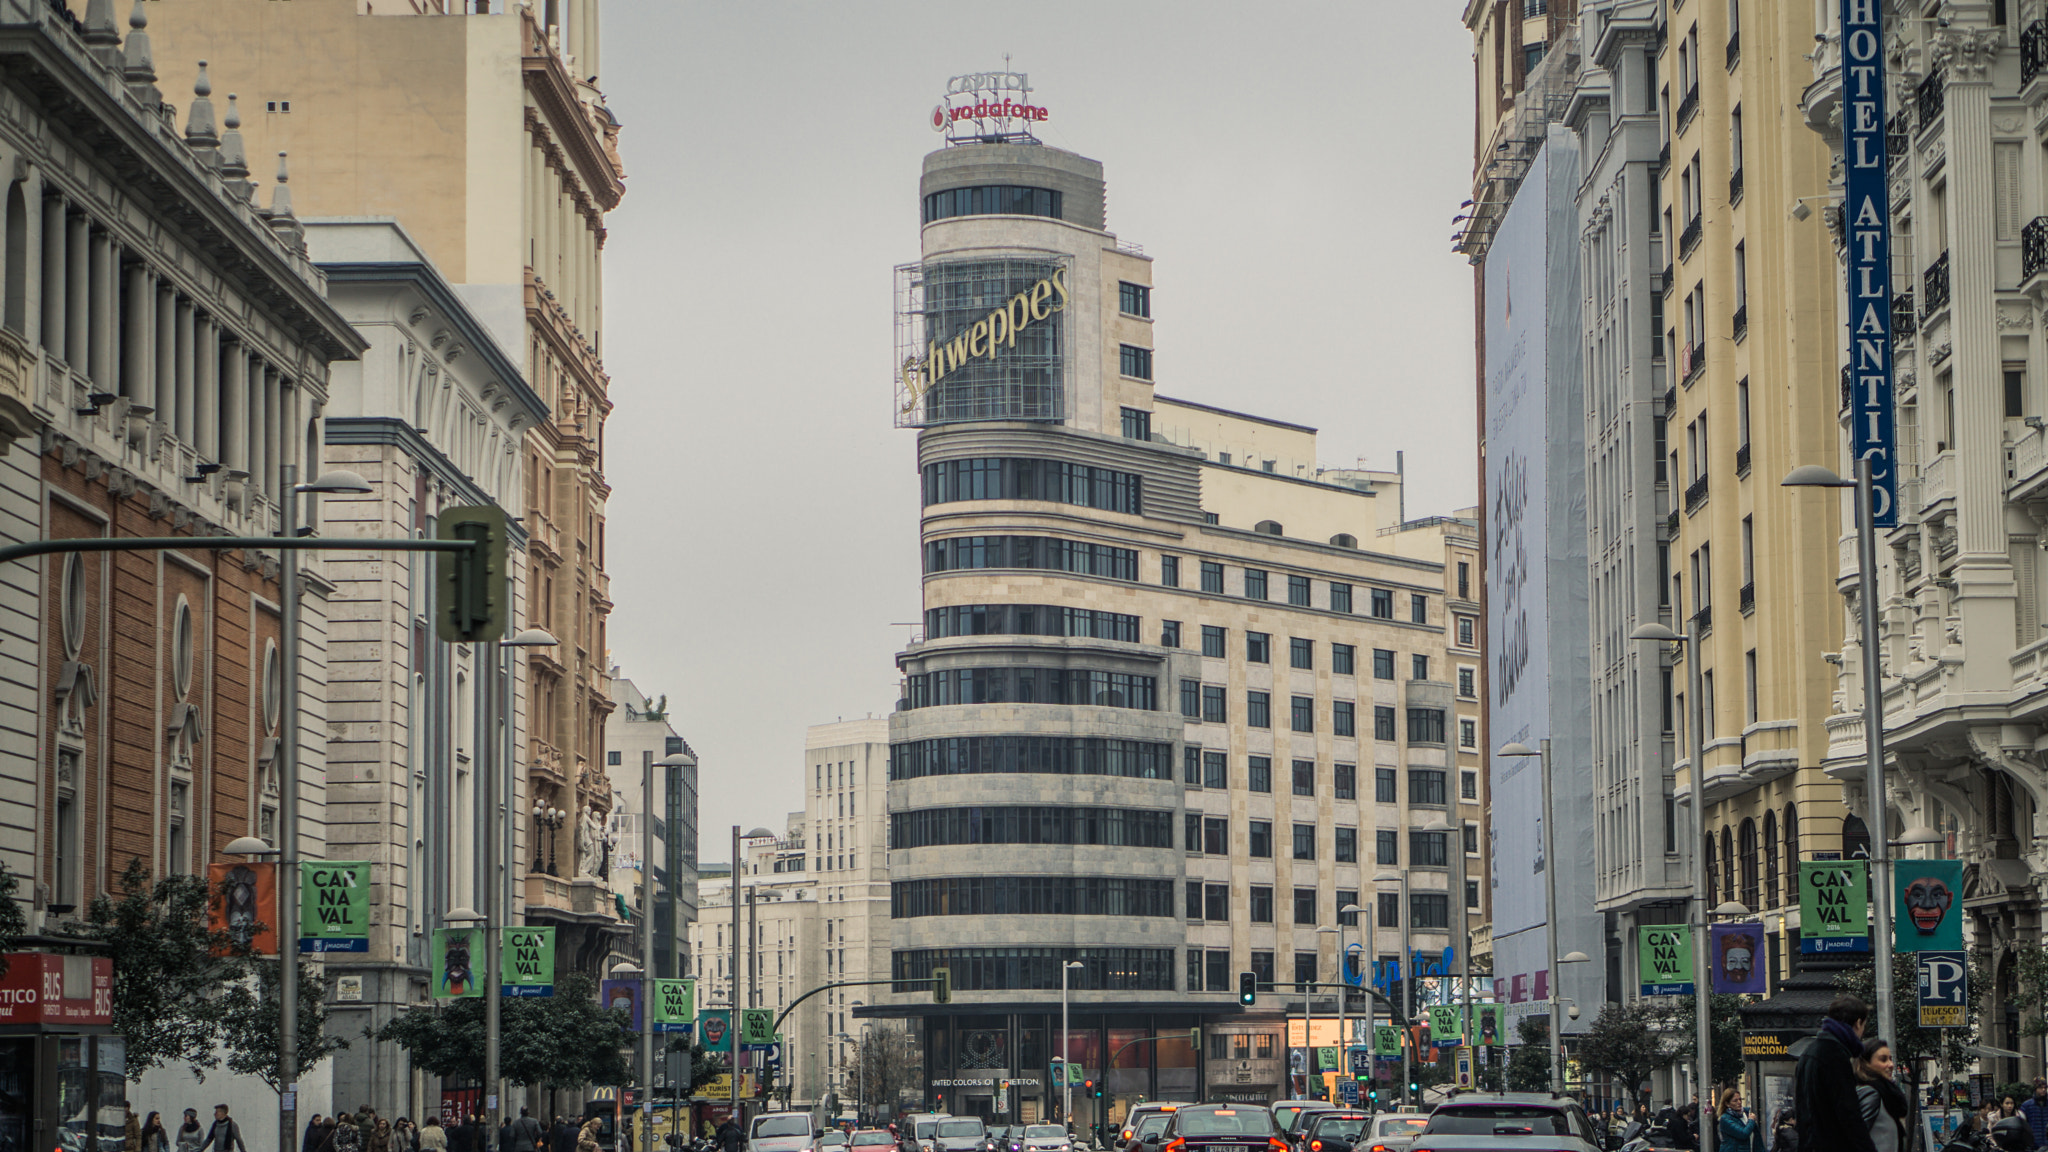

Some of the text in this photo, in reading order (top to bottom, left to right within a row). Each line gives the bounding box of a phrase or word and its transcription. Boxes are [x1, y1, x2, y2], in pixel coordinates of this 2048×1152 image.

[947, 72, 1034, 94] CAPITOL
[1847, 0, 1879, 168] HOTEL
[949, 98, 1049, 121] vodafone
[902, 265, 1069, 414] Schweppes
[313, 870, 357, 888] CAR
[1810, 870, 1853, 887] CAR
[320, 889, 350, 905] NA
[1818, 888, 1848, 905] NA
[317, 907, 353, 924] VAL
[1816, 907, 1852, 923] VAL
[511, 934, 544, 948] CAR
[1648, 932, 1681, 946] CAR
[517, 948, 540, 961] NA
[1654, 947, 1678, 960] NA
[515, 962, 542, 975] VAL
[1343, 943, 1454, 997] Captol
[1653, 961, 1681, 974] VAL
[43, 972, 60, 1001] BUS
[1922, 961, 1963, 999] P
[95, 988, 111, 1017] BUS
[665, 995, 683, 1005] NA
[664, 1006, 684, 1016] VAL
[1744, 1035, 1781, 1045] NACIONAL
[932, 1079, 951, 1087] UNITED
